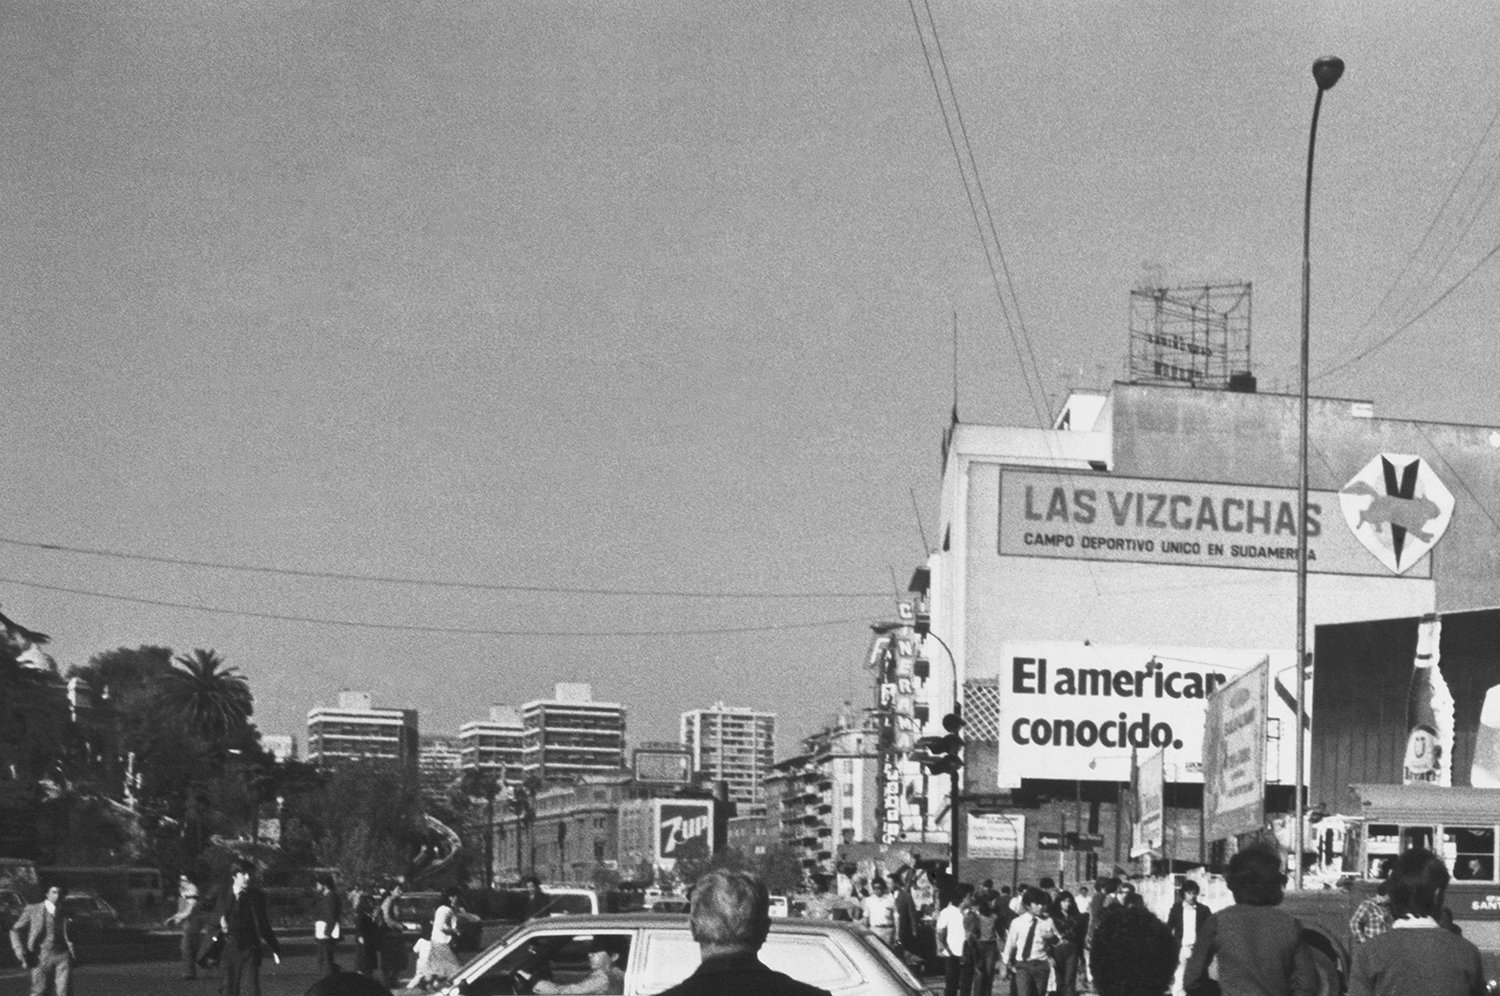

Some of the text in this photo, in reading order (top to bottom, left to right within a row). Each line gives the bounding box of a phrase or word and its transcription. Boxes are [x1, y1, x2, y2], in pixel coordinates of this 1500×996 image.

[1024, 484, 1323, 538] LAS VIZCACHAS
[1023, 531, 1075, 549] CAMPO
[1080, 535, 1155, 553] DEPORTIVO
[1161, 541, 1201, 556] UNICO
[1207, 543, 1224, 556] EN
[1012, 656, 1047, 695] El
[1011, 711, 1184, 750] conocido.
